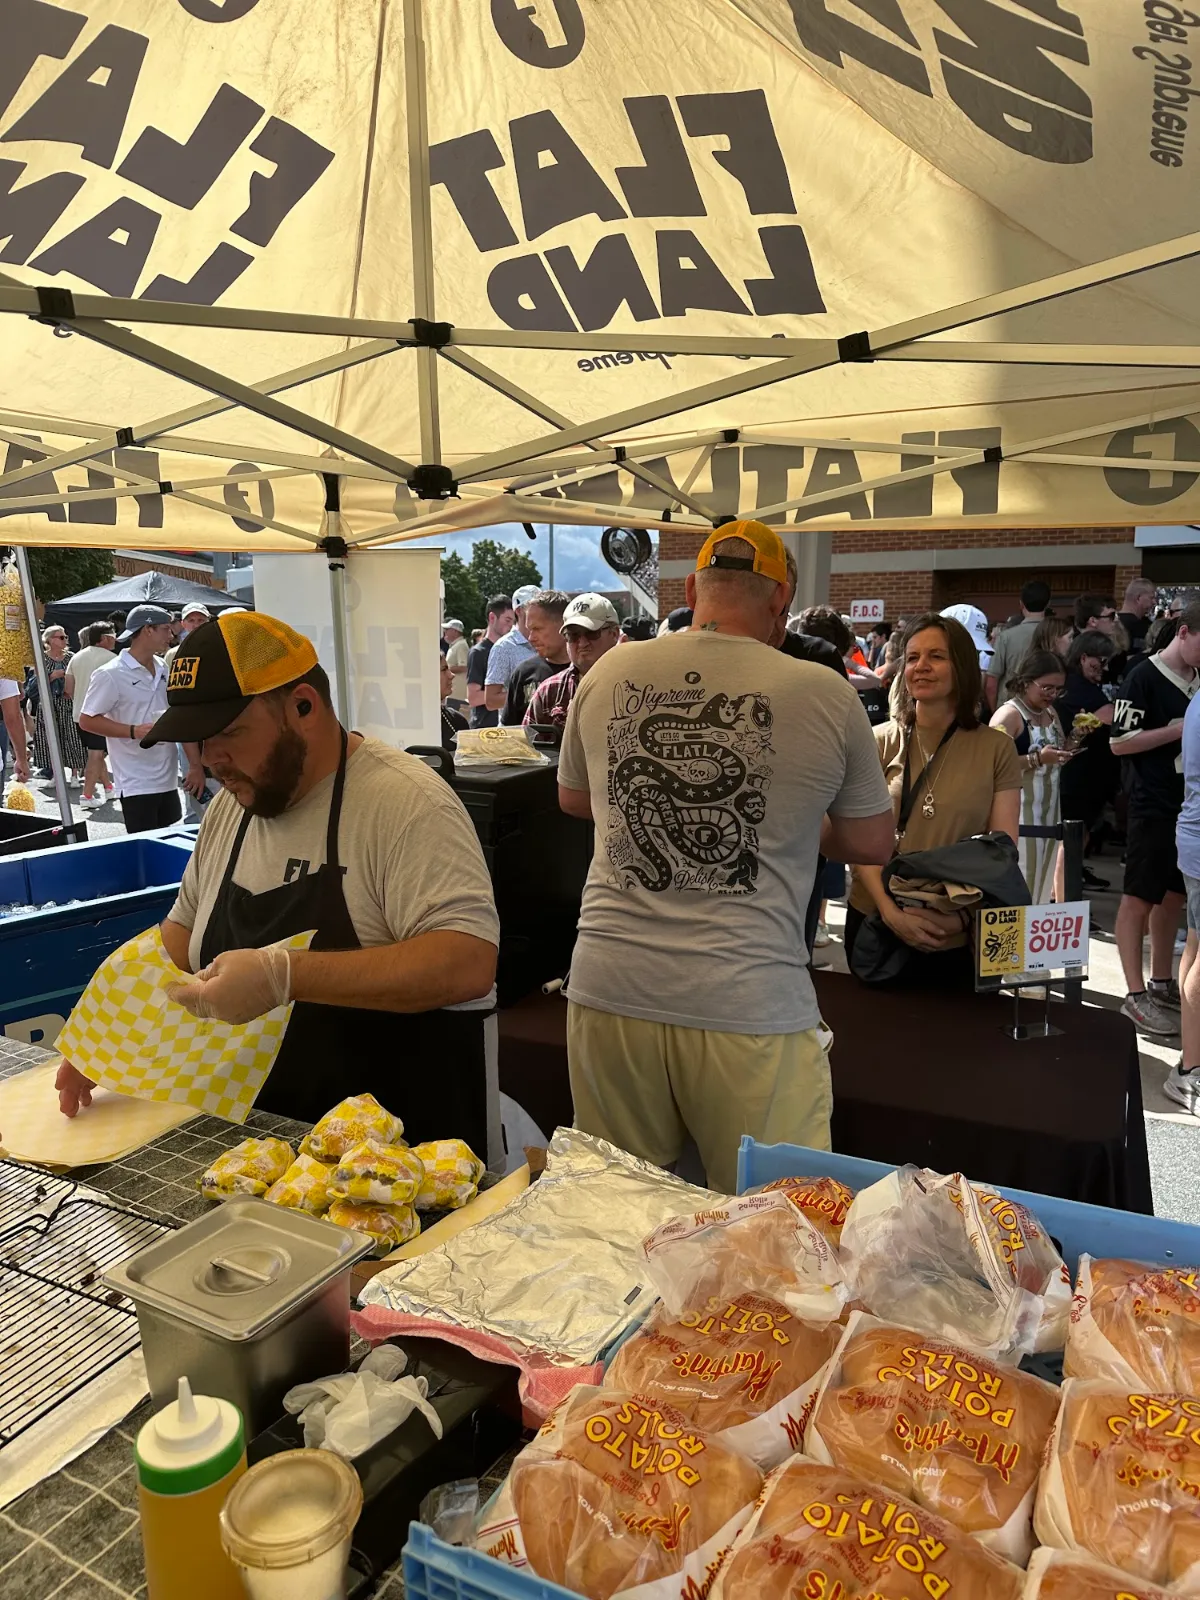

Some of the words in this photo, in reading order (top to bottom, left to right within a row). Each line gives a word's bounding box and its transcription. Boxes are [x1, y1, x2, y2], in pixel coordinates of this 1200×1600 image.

[852, 605, 882, 617] F.D.C.
[626, 684, 706, 715] Supreme
[1113, 699, 1145, 731] WF
[662, 744, 741, 777] FLATLAND
[628, 799, 648, 845] BURGER
[641, 787, 679, 832] SUPREME
[673, 867, 719, 892] Delish
[999, 909, 1018, 918] FLAT
[999, 916, 1017, 924] LAND
[1030, 916, 1074, 935] SOLD
[671, 1349, 783, 1401] Martin's
[899, 1346, 1004, 1398] ROLLS
[585, 1414, 702, 1488] POTATO
[893, 1412, 1020, 1484] Martin's
[802, 1501, 953, 1600] POTATO
